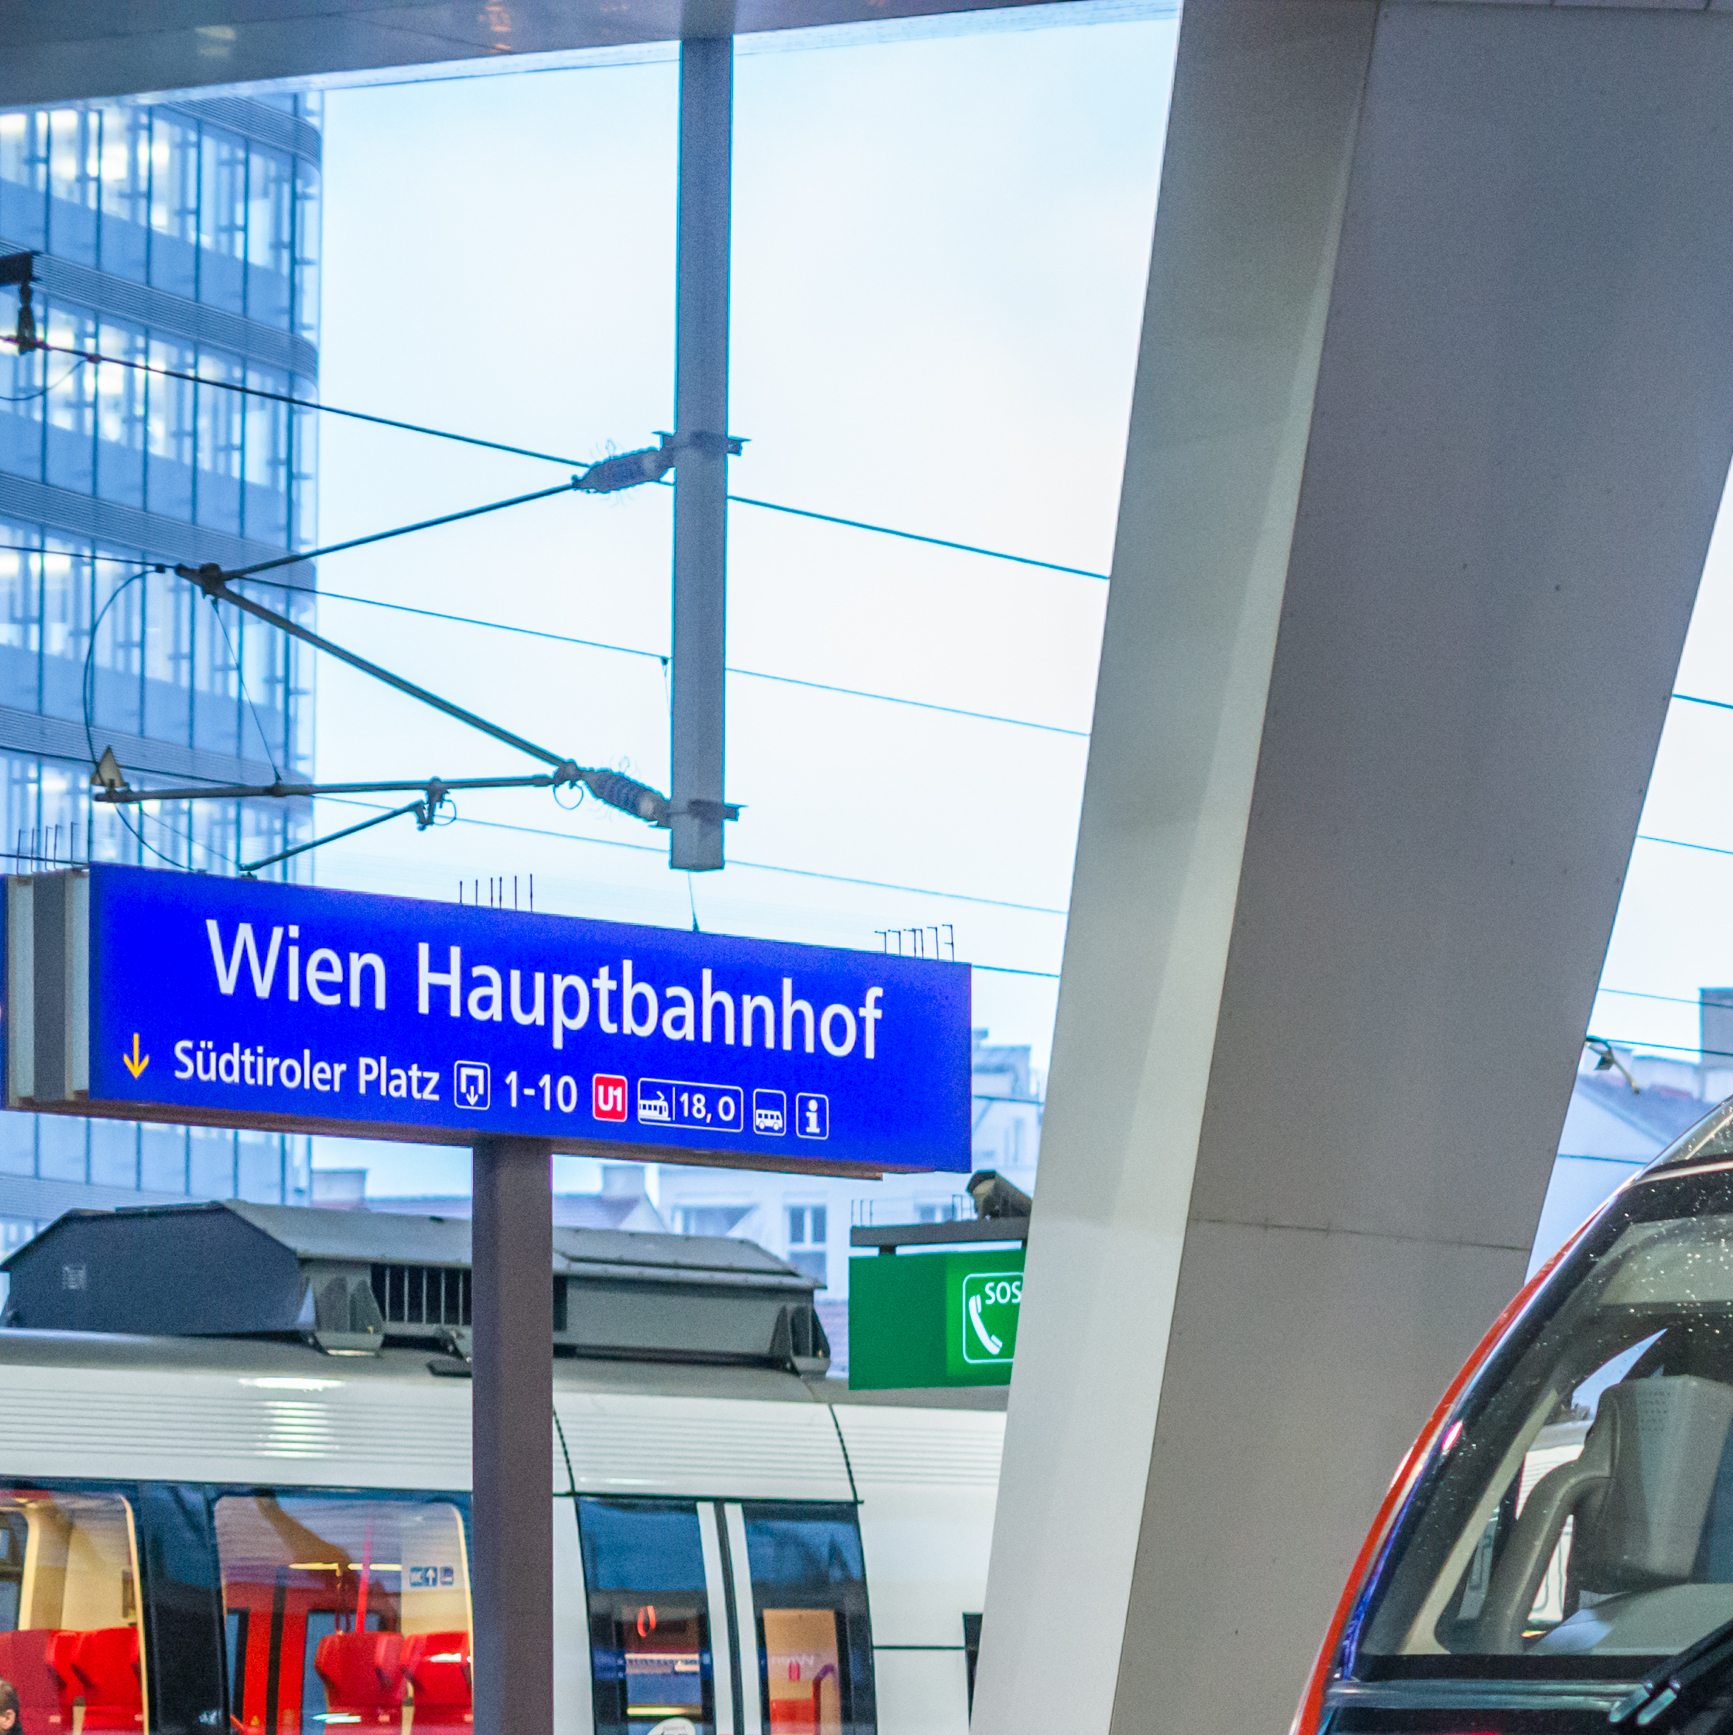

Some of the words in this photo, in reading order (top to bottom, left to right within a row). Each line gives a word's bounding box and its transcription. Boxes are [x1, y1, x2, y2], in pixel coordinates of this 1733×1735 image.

[206, 918, 388, 1010] Wien
[416, 941, 883, 1060] Hauptbahnhof
[173, 1039, 346, 1097] Südtiroler
[357, 1055, 440, 1102] Platz
[504, 1072, 577, 1113] 1-10
[598, 1085, 623, 1112] U1
[984, 1281, 1022, 1305] SOS
